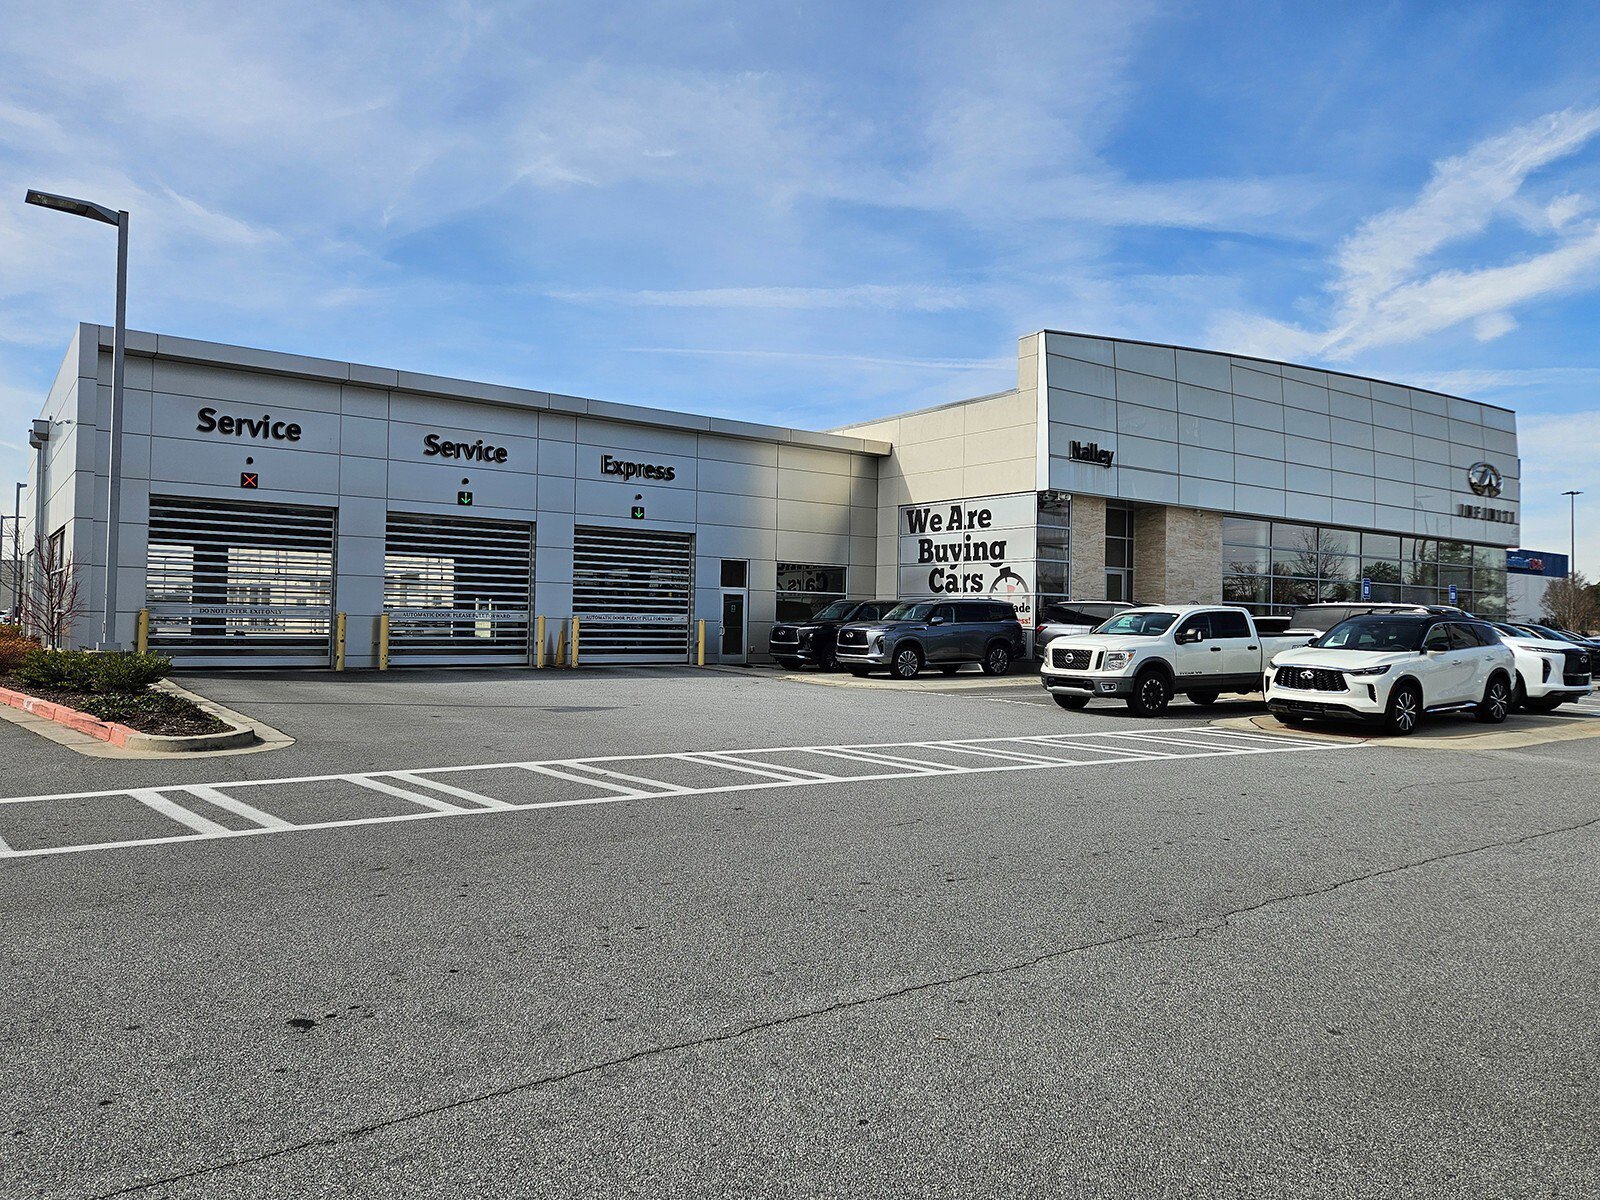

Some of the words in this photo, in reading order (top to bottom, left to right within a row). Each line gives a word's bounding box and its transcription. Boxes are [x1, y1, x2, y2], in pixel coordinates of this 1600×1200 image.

[197, 407, 302, 442] Service
[423, 434, 508, 464] Service
[1068, 440, 1114, 468] Nalley
[600, 455, 676, 481] Express
[906, 508, 943, 534] We
[946, 505, 992, 531] Are
[1457, 503, 1515, 524] INFINITI
[918, 534, 1007, 570] Buying
[928, 567, 984, 594] Cars
[1013, 603, 1031, 613] ade
